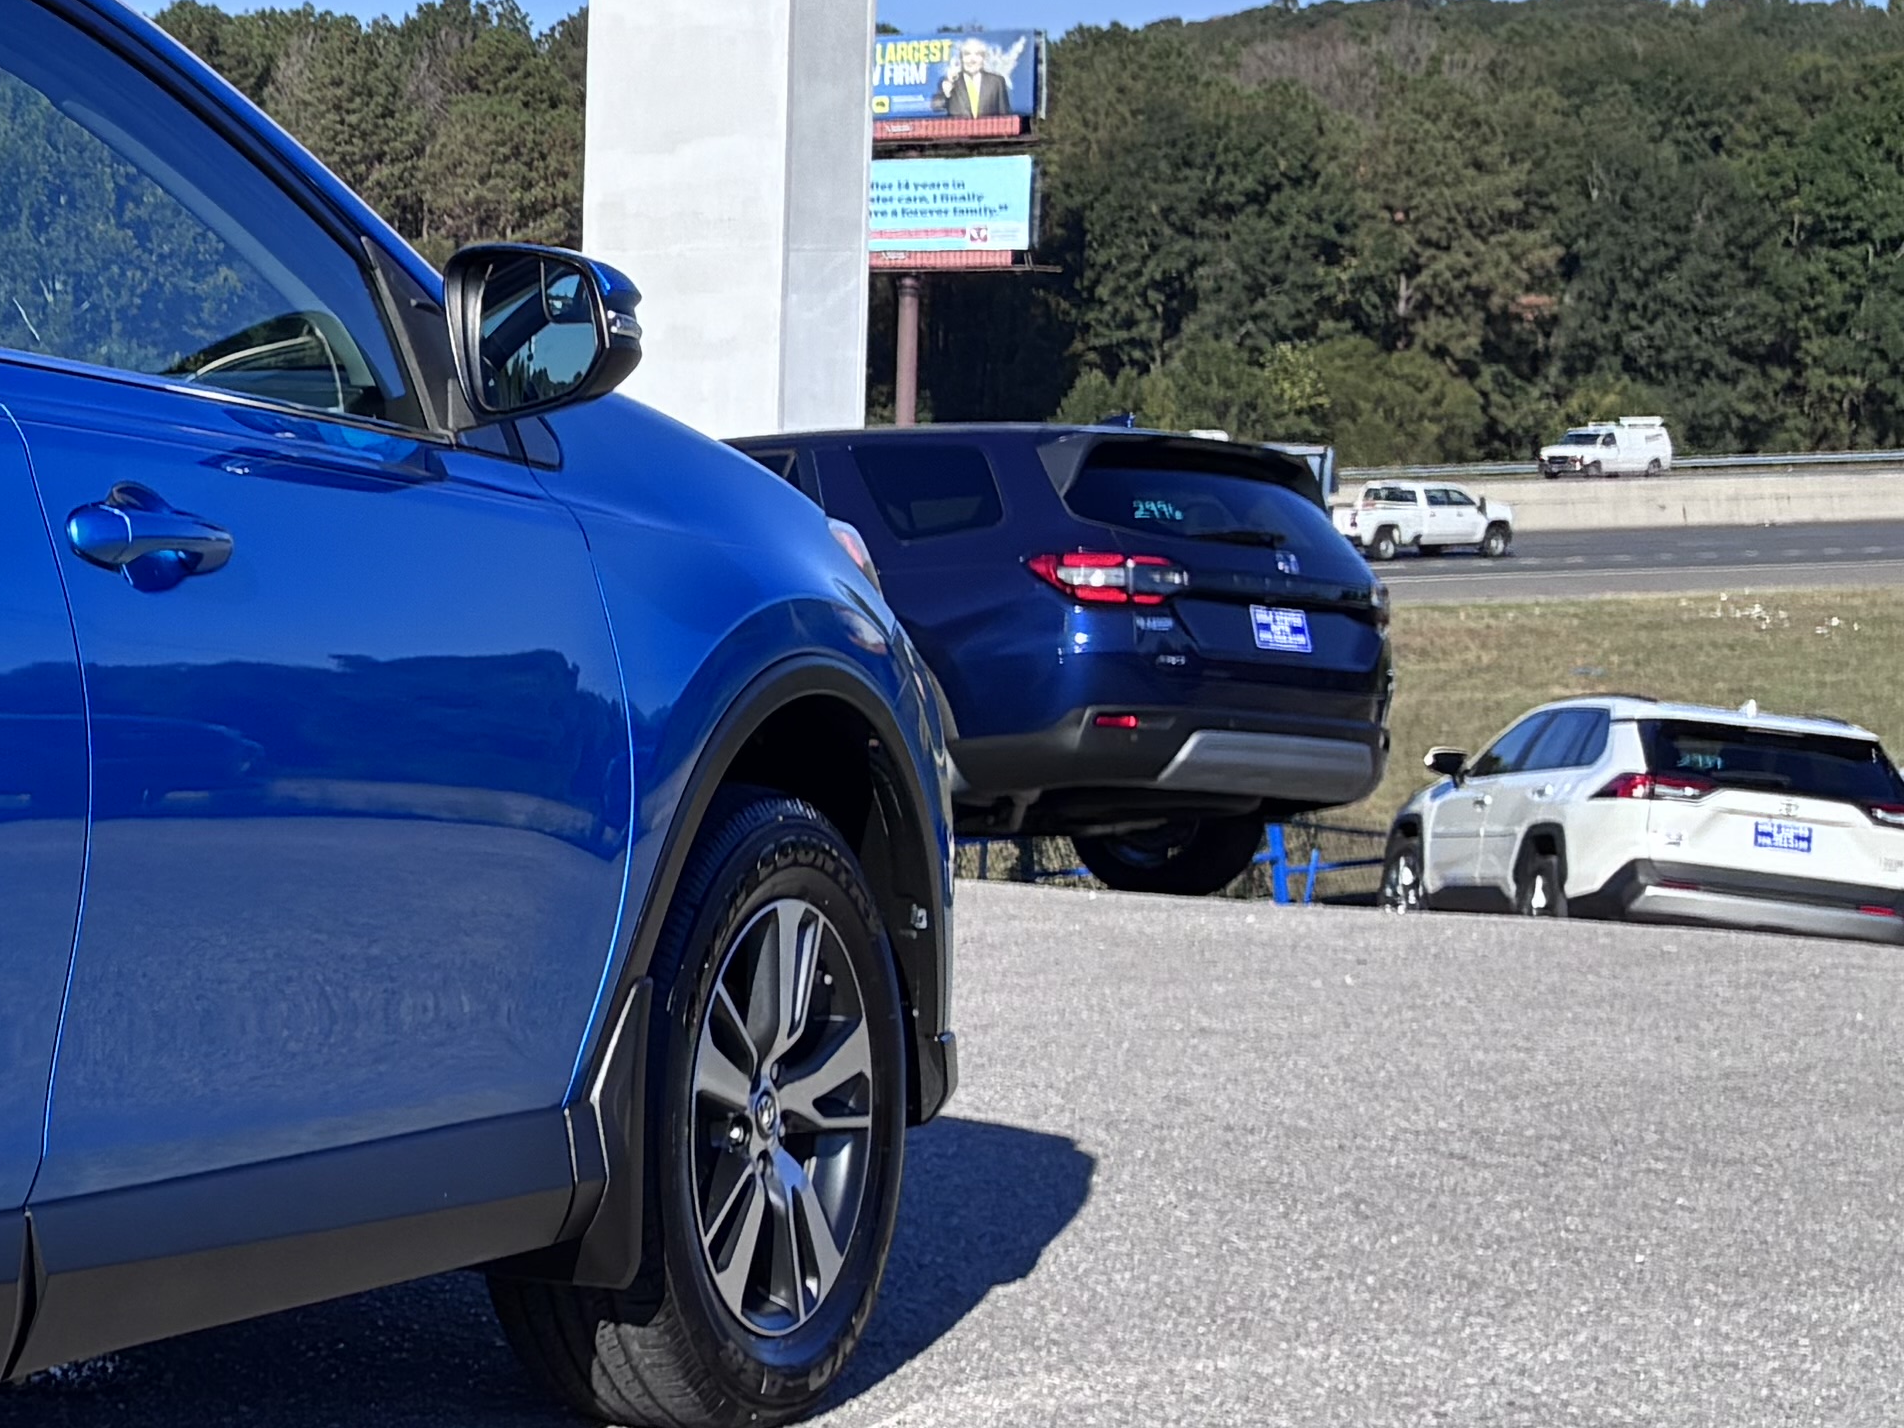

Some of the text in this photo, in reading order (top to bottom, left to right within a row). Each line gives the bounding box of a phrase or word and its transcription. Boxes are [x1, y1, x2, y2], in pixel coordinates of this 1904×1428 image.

[875, 39, 952, 66] LARGEST
[884, 62, 928, 86] FIRM
[870, 180, 893, 191] fter
